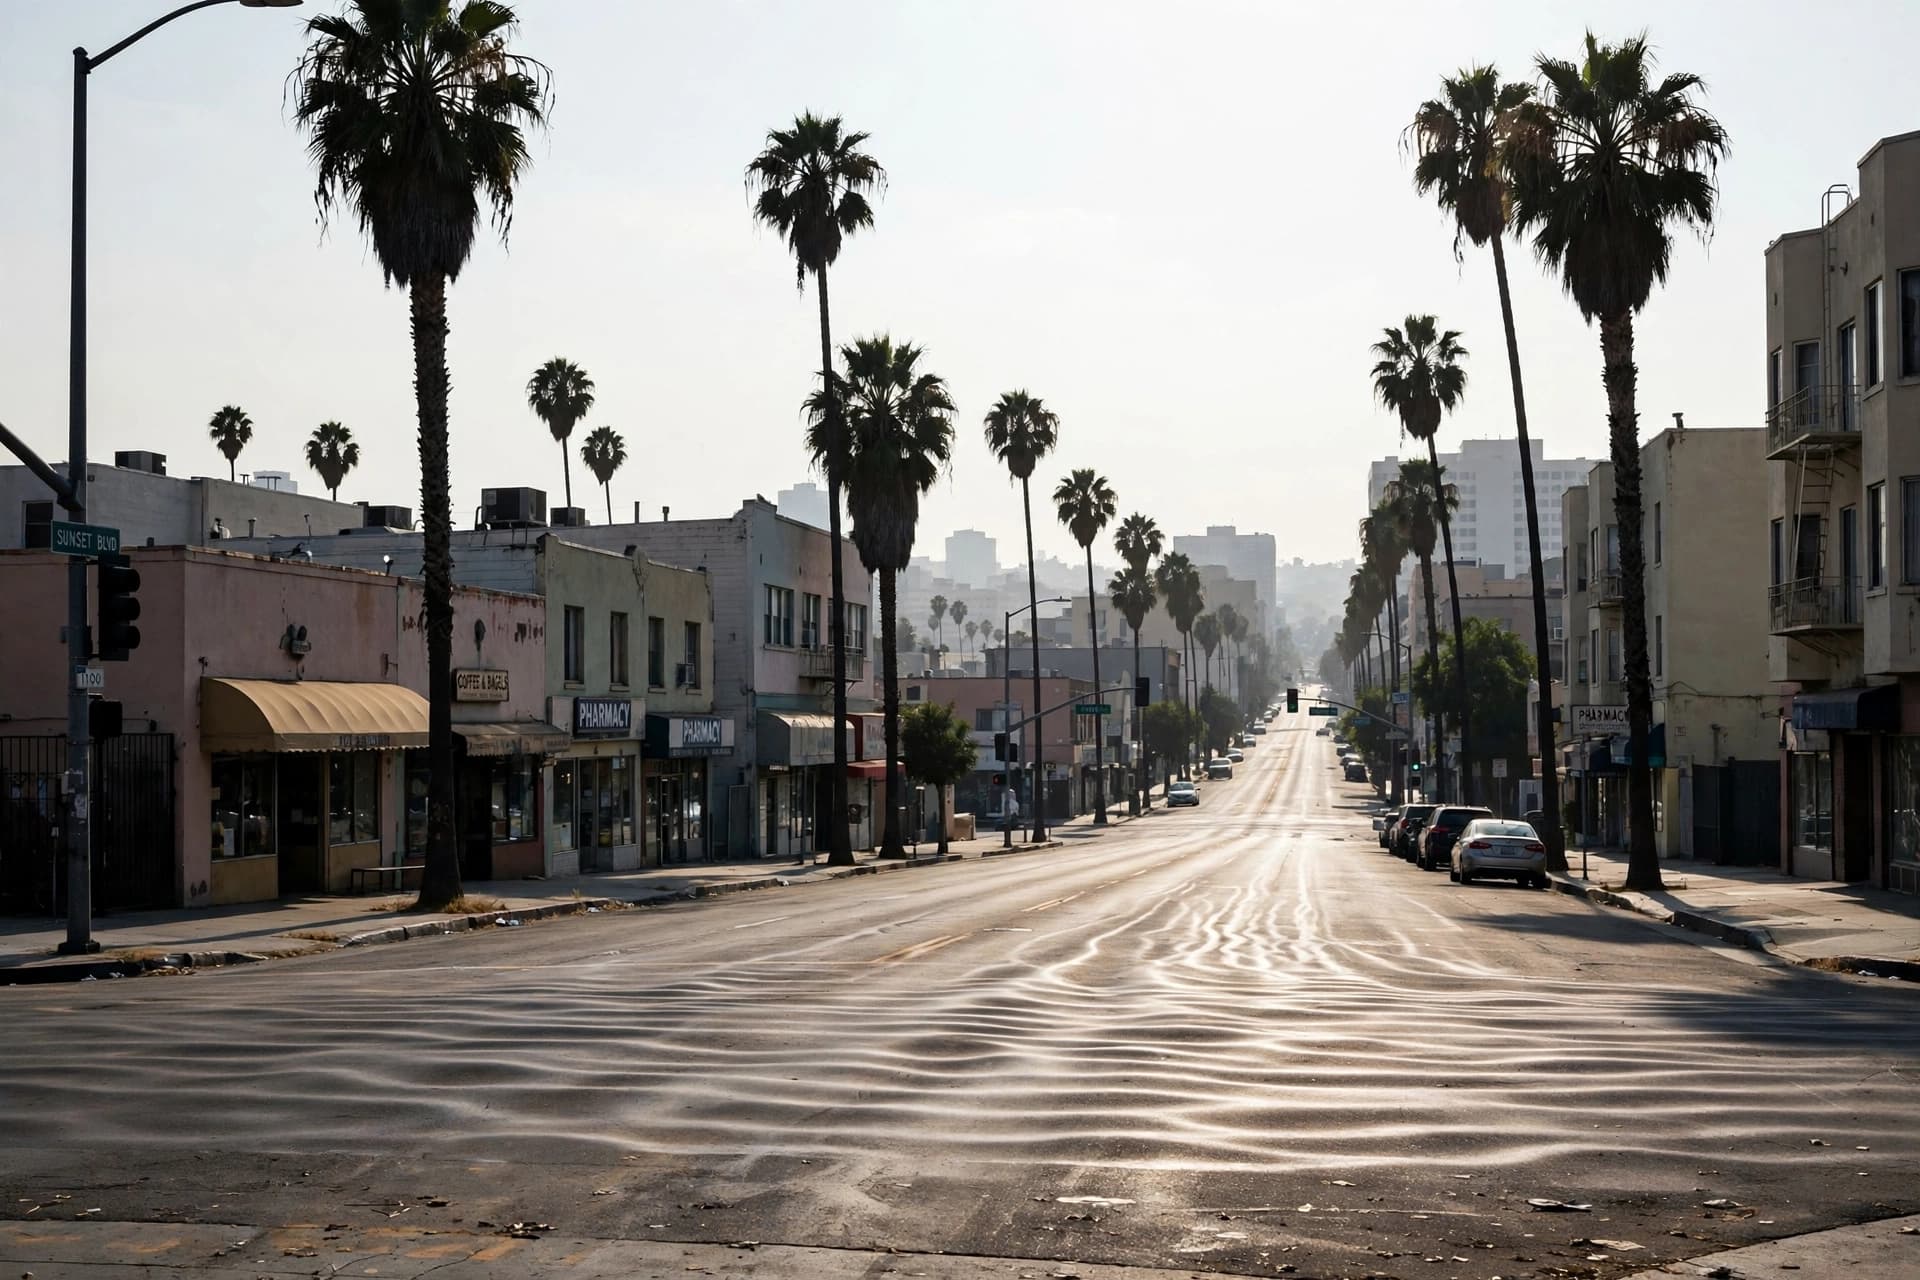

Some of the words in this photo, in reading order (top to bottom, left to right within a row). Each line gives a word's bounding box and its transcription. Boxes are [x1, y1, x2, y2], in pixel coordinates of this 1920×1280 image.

[56, 528, 92, 549] SUNSET
[97, 534, 117, 551] BLVD
[81, 672, 102, 685] 1100
[457, 673, 480, 690] COFFEE
[487, 674, 509, 691] BAGELS
[579, 703, 631, 728] PHARMACY
[683, 719, 721, 745] PHARMACY
